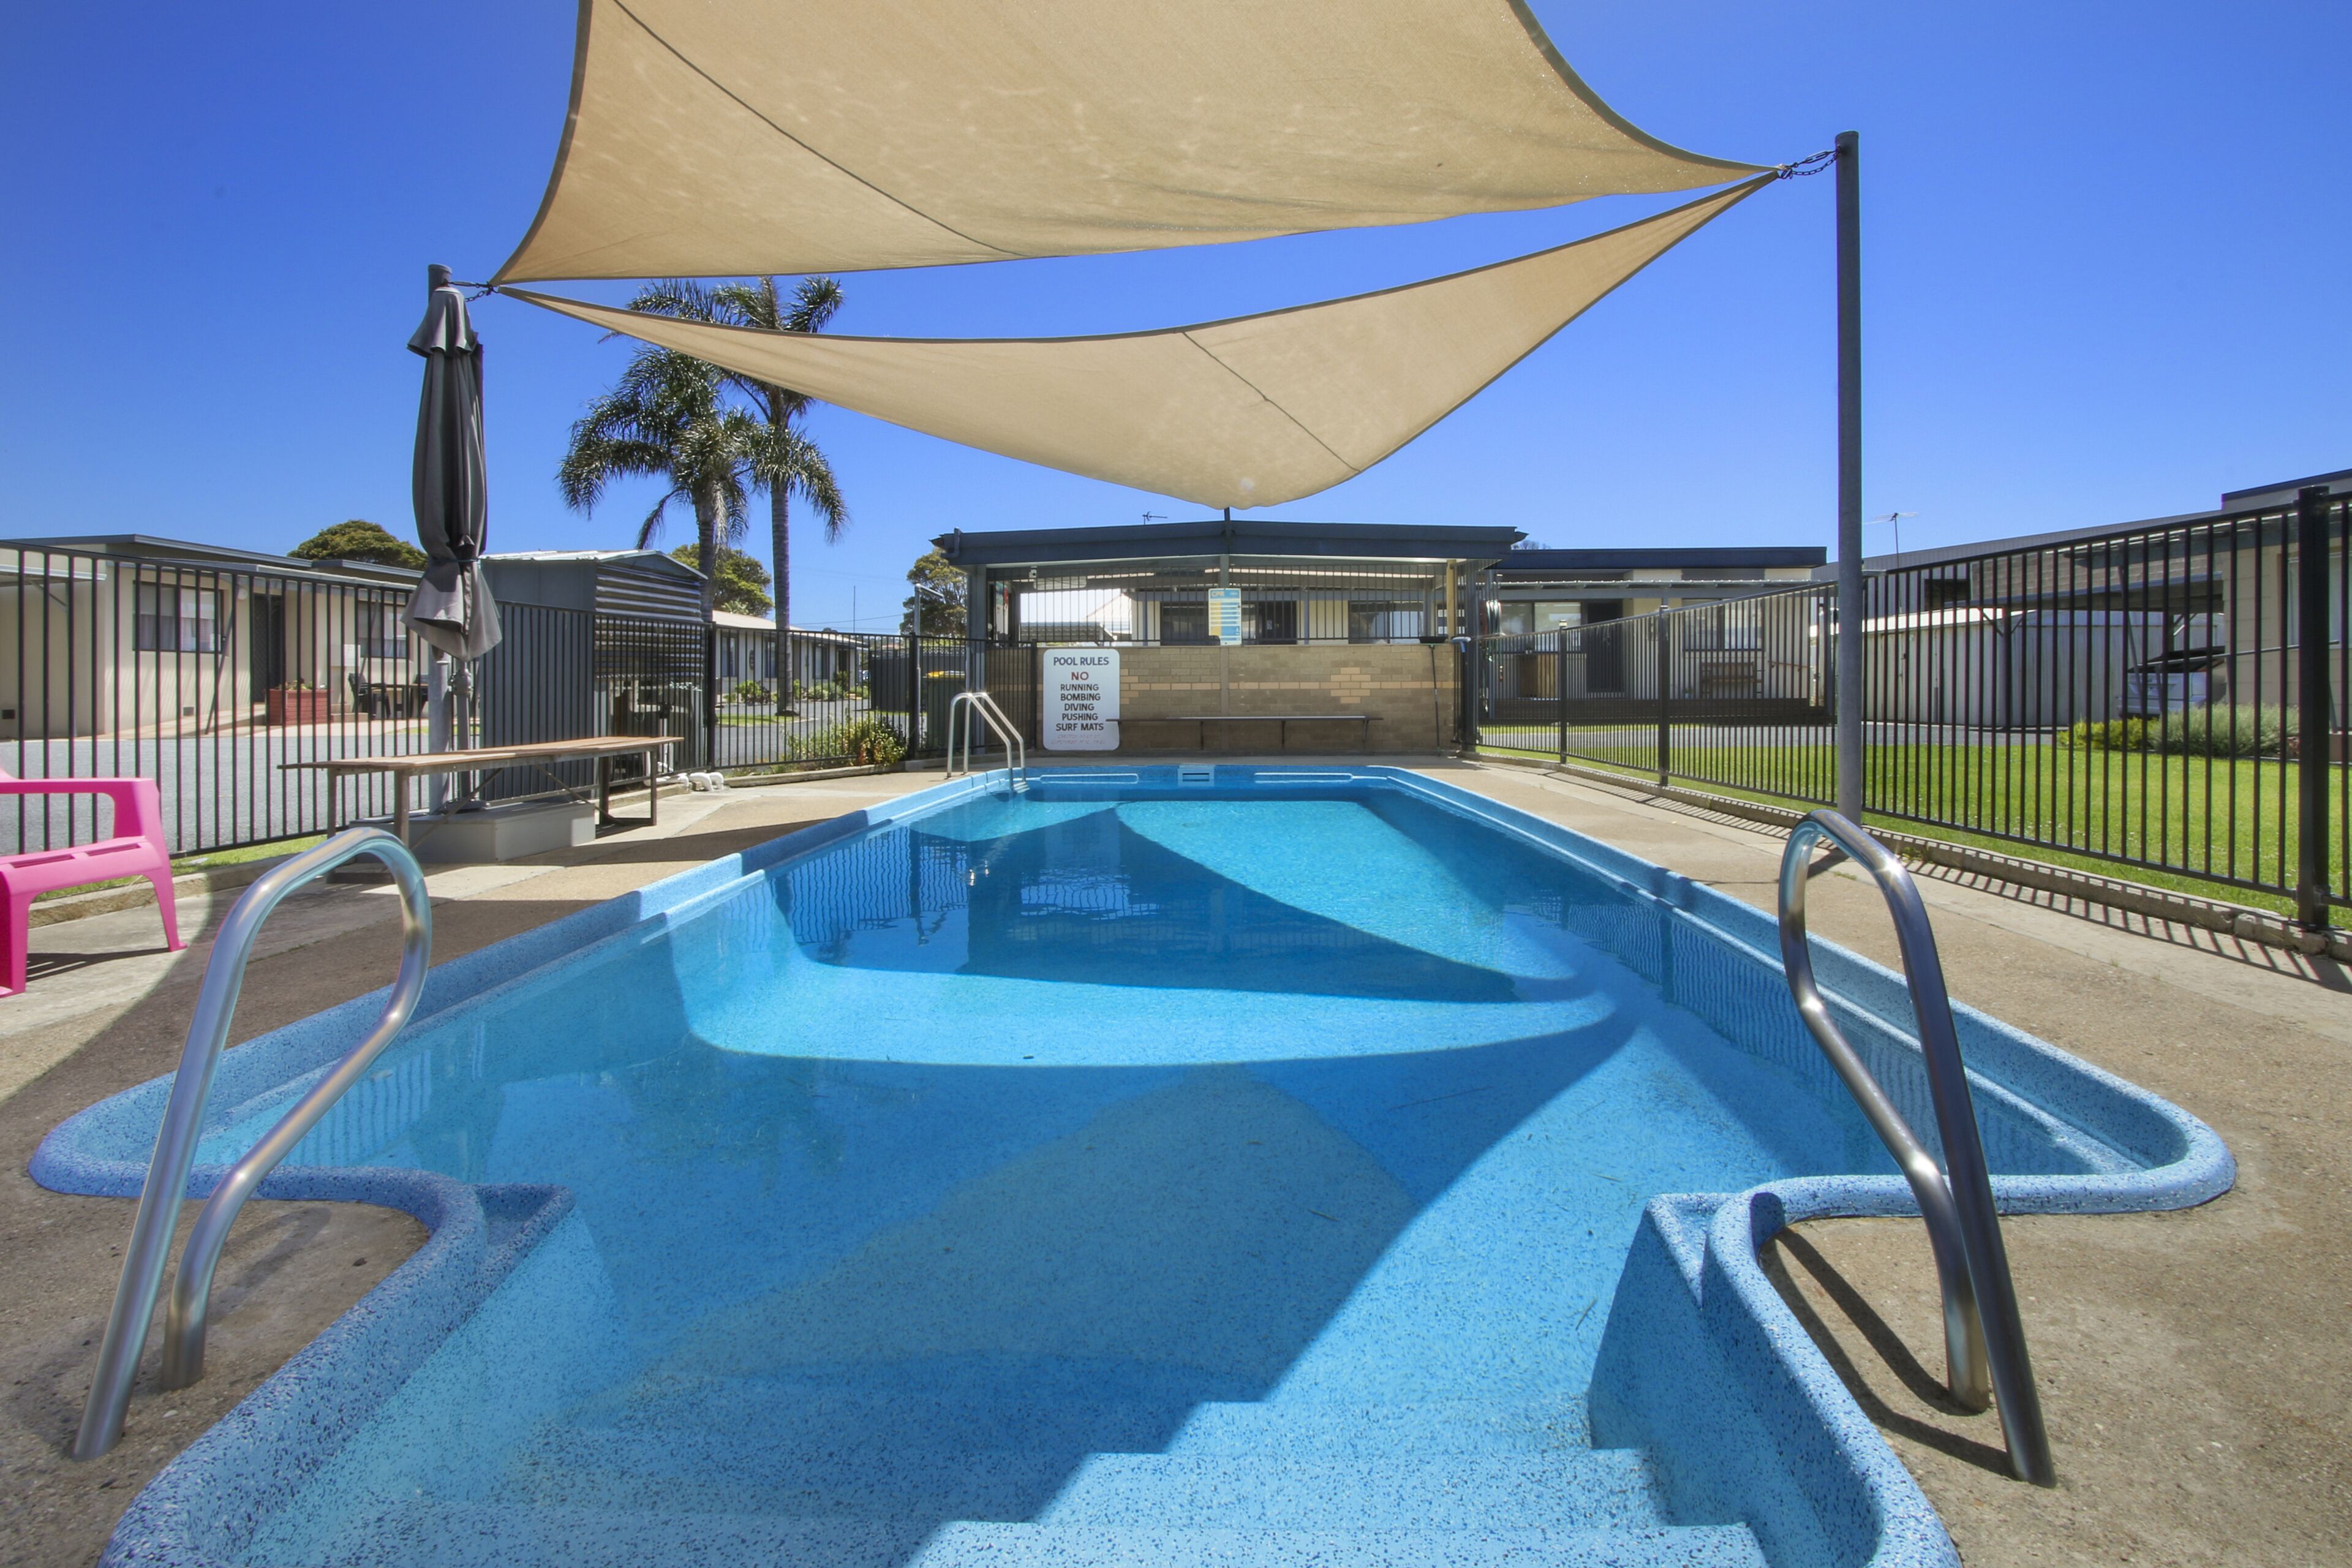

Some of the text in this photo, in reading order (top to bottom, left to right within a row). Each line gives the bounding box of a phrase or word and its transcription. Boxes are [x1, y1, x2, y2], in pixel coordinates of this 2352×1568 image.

[1054, 657, 1109, 666] POOL RULES
[1071, 671, 1089, 680] NO
